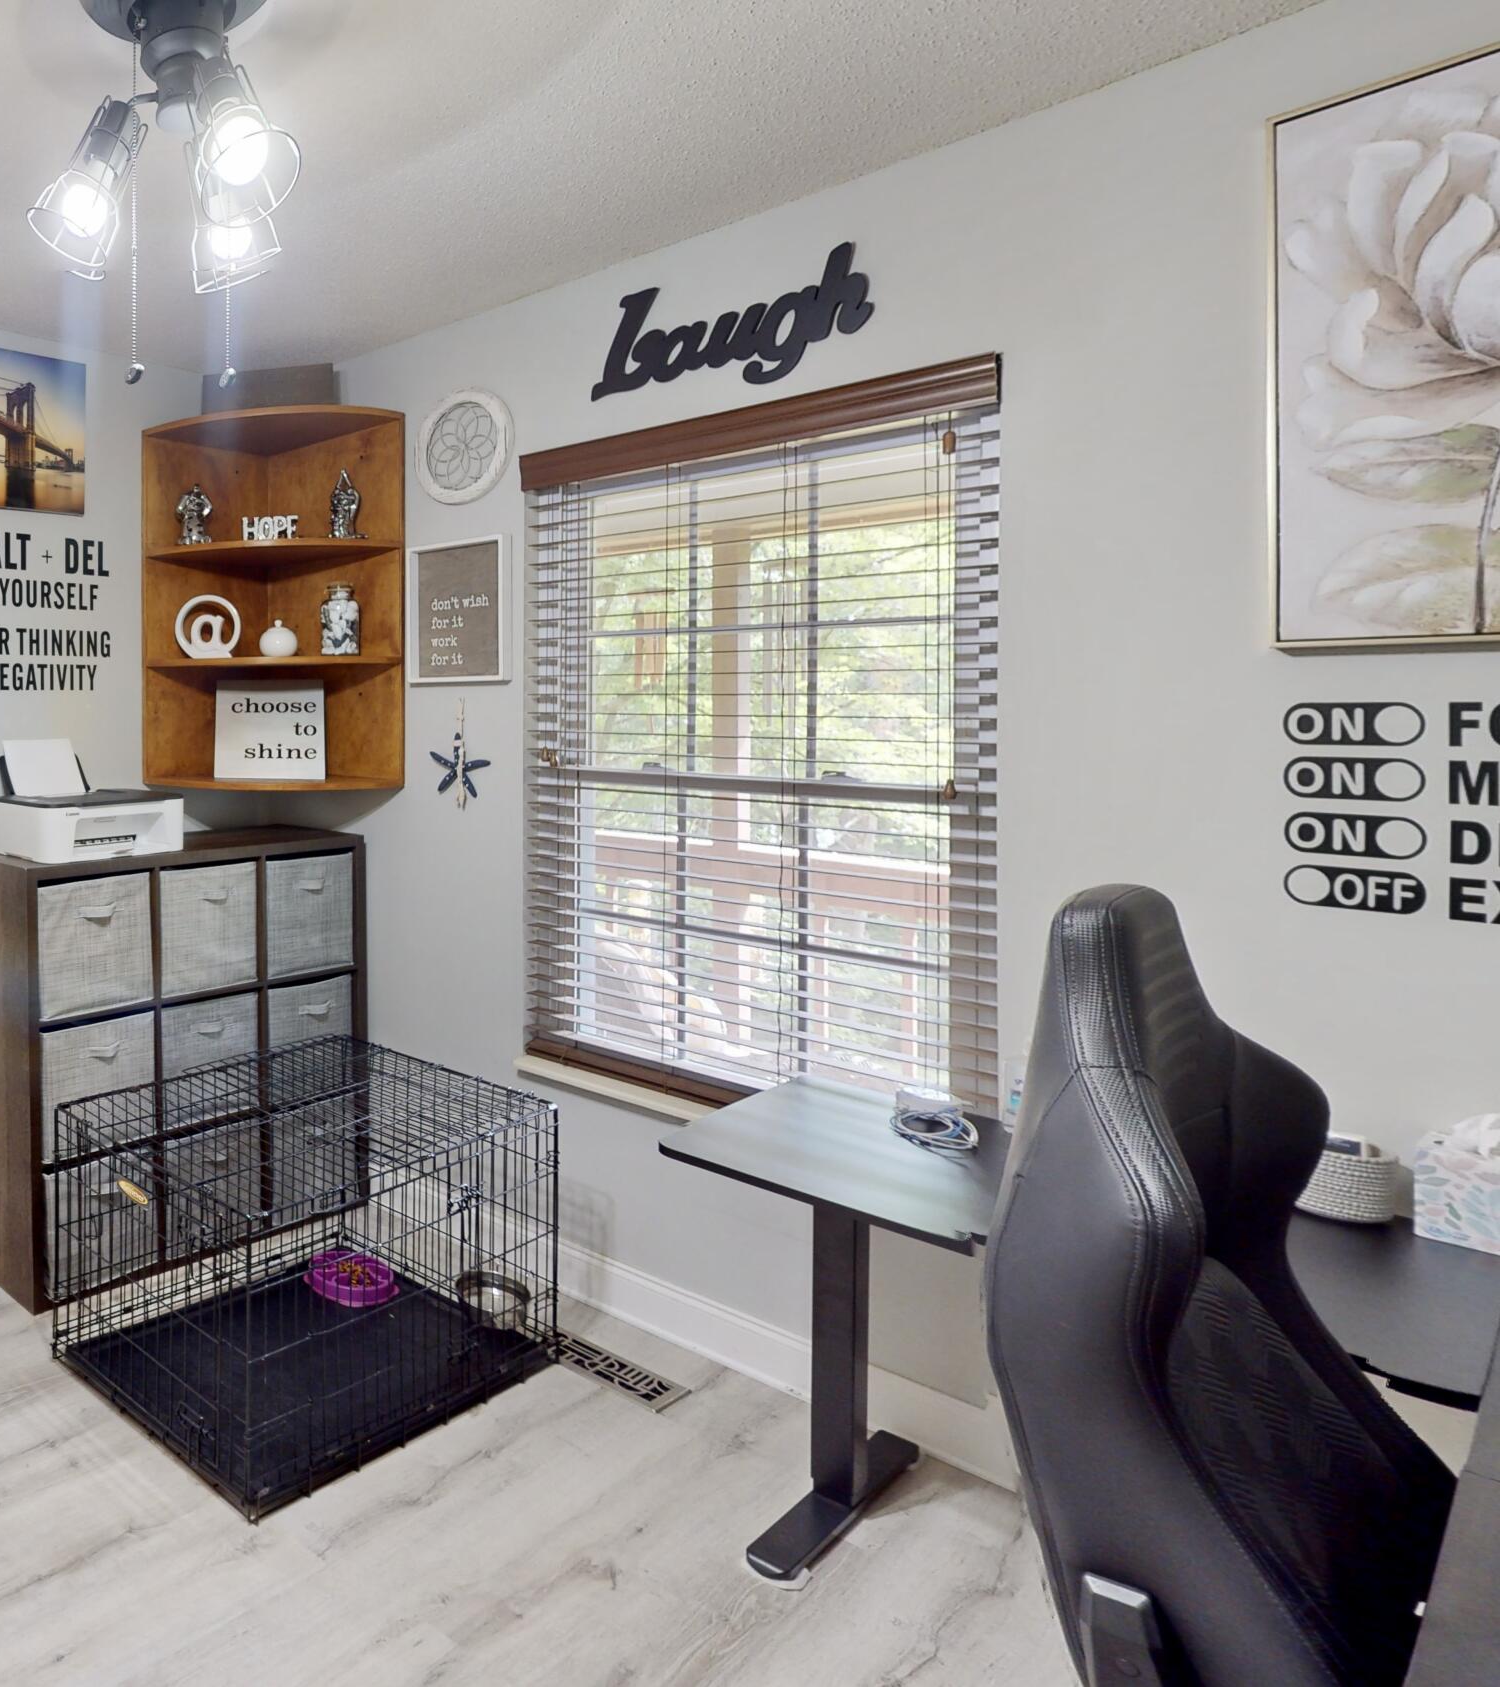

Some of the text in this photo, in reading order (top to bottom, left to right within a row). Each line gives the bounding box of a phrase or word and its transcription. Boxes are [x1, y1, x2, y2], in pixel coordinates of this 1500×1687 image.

[591, 241, 875, 402] Laugh
[242, 515, 298, 540] HOPE
[65, 538, 109, 577] DEL
[0, 578, 98, 611] YOURSELF
[431, 593, 489, 611] don't wish
[431, 615, 464, 629] for it
[16, 628, 111, 657] THINKING
[430, 634, 457, 647] work
[431, 653, 463, 666] for it
[231, 697, 317, 714] choose
[293, 721, 317, 736] to
[1287, 701, 1500, 746] ON F
[244, 743, 317, 760] shine
[1287, 760, 1365, 796] ON
[1288, 815, 1500, 866] ON D
[1333, 873, 1500, 924] OFF E
